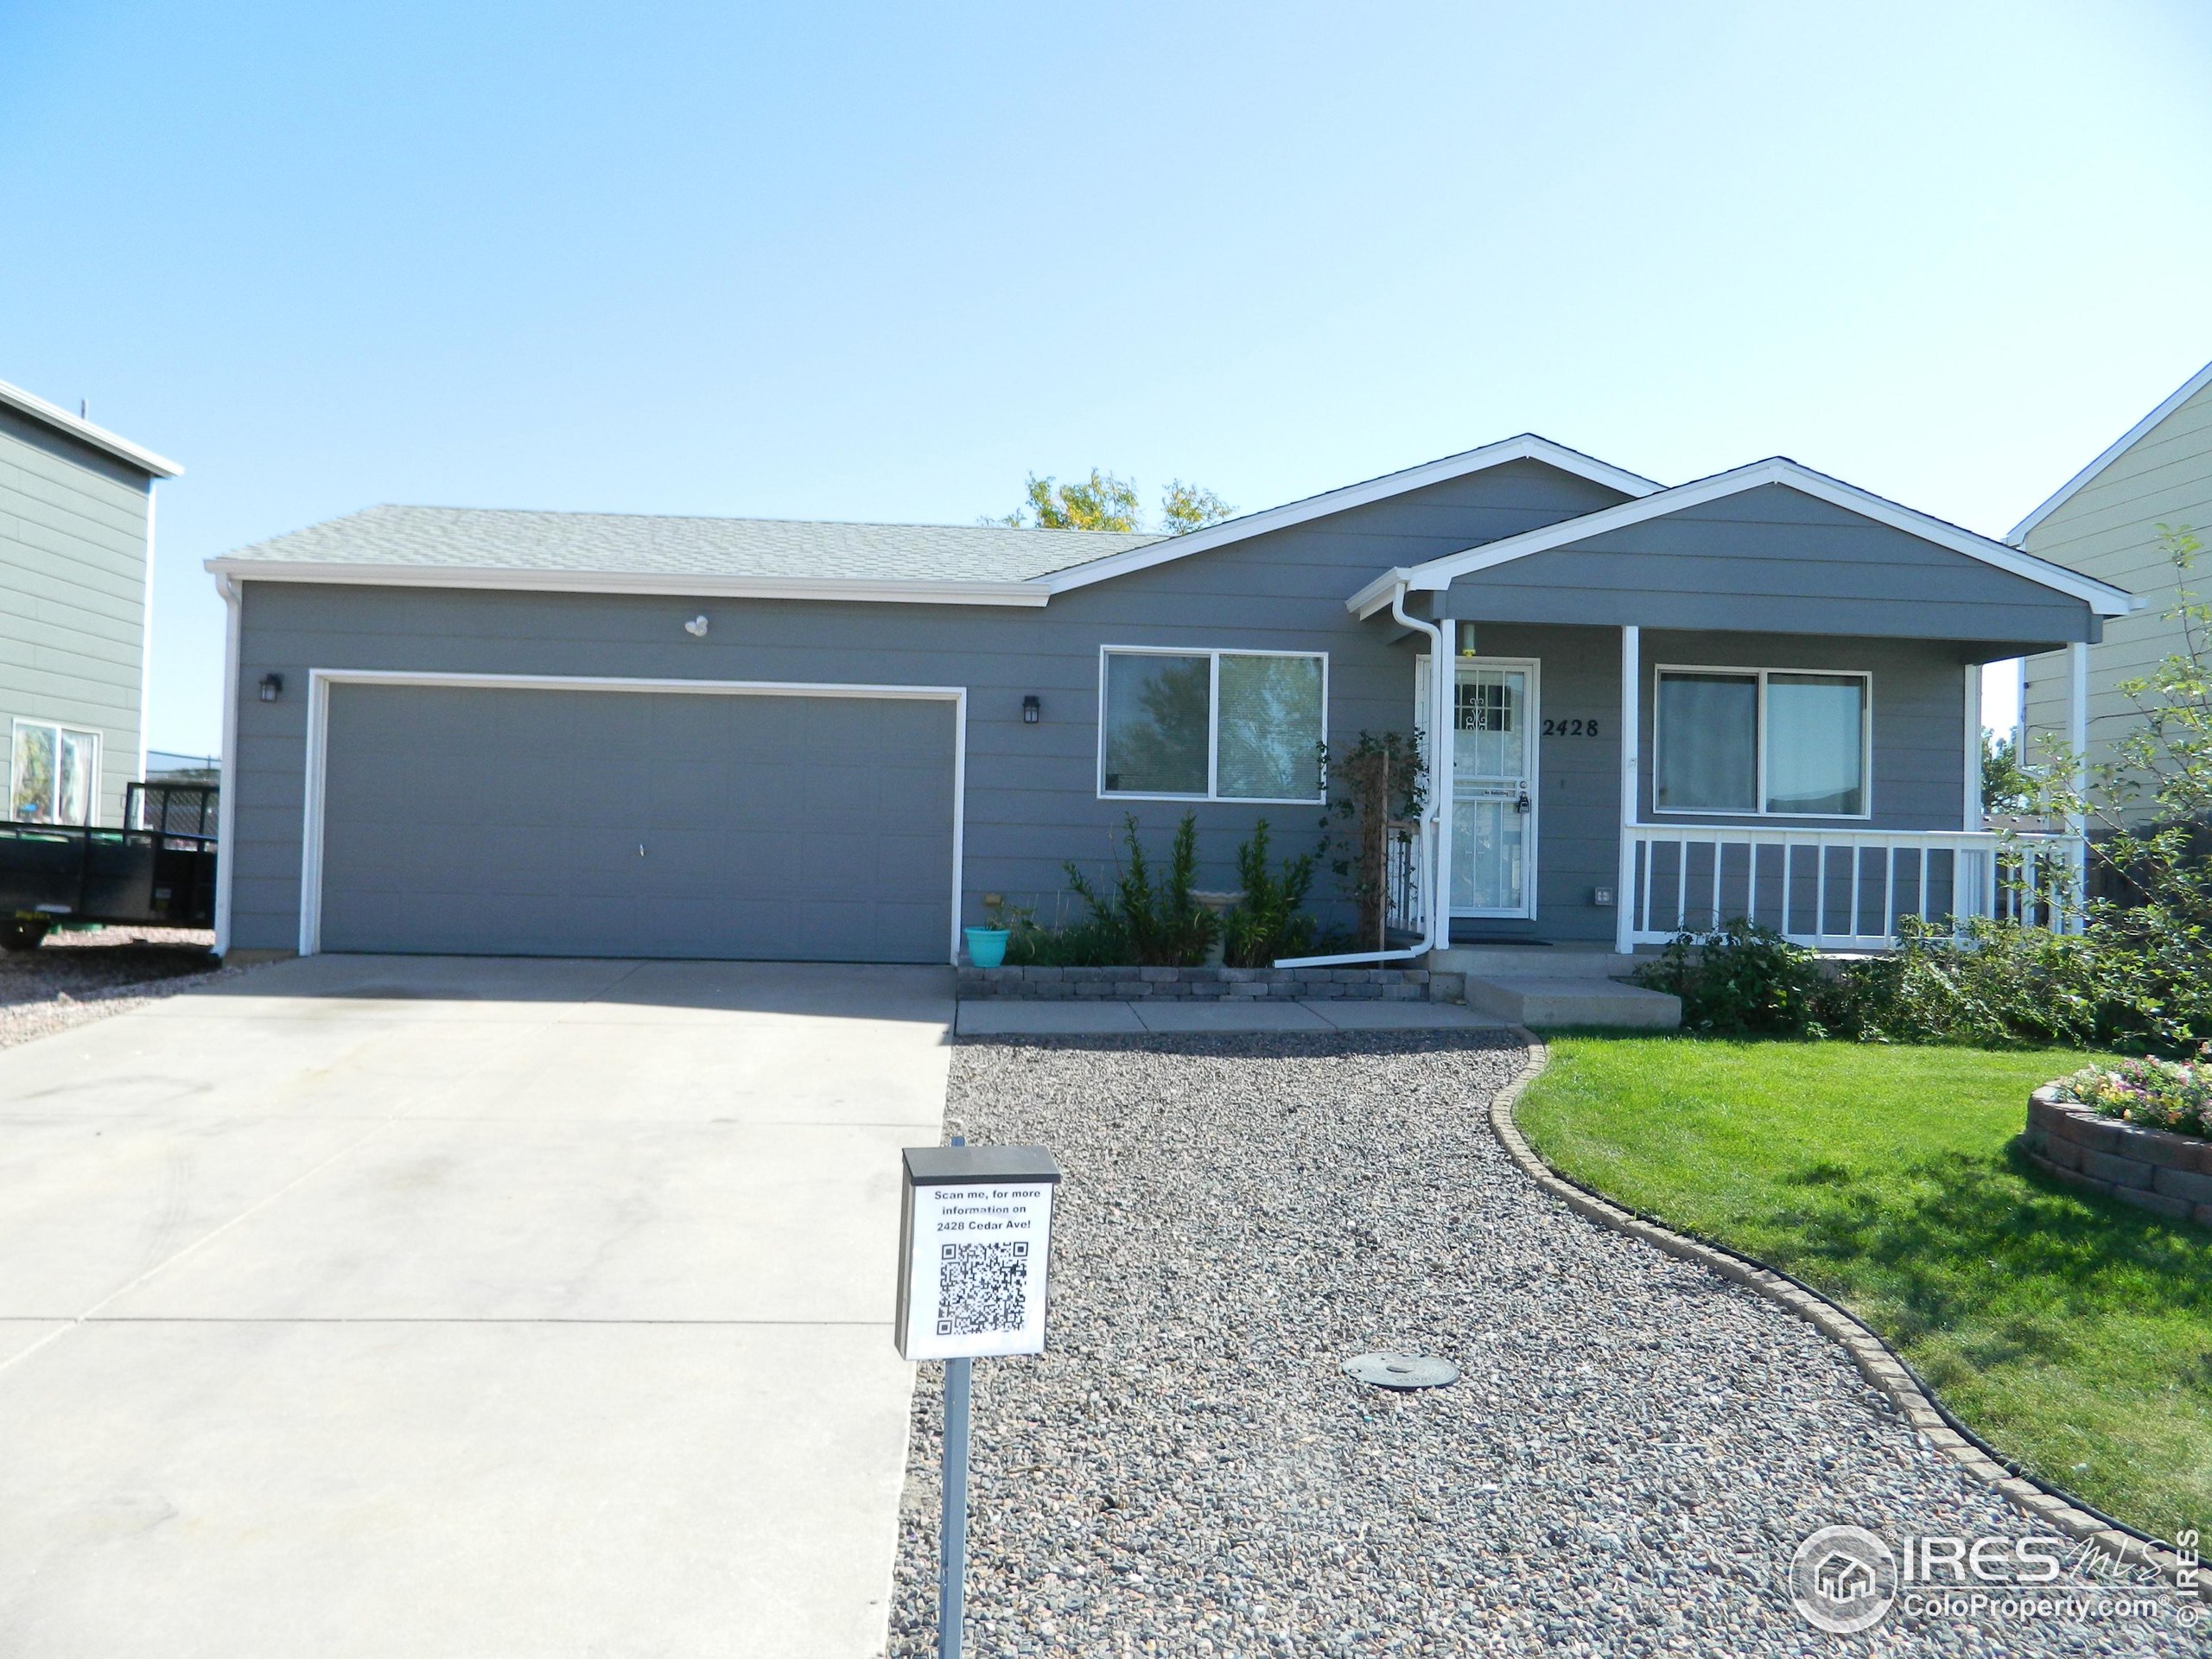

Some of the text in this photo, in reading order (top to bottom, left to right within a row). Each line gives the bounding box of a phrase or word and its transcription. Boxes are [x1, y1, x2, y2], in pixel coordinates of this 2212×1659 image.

[1542, 719, 1599, 737] 2428
[934, 1191, 963, 1200] Scan
[967, 1191, 988, 1200] me,
[993, 1190, 1008, 1198] for
[942, 1205, 1009, 1215] information
[937, 1219, 1031, 1231] 2428 Cedar Ave!
